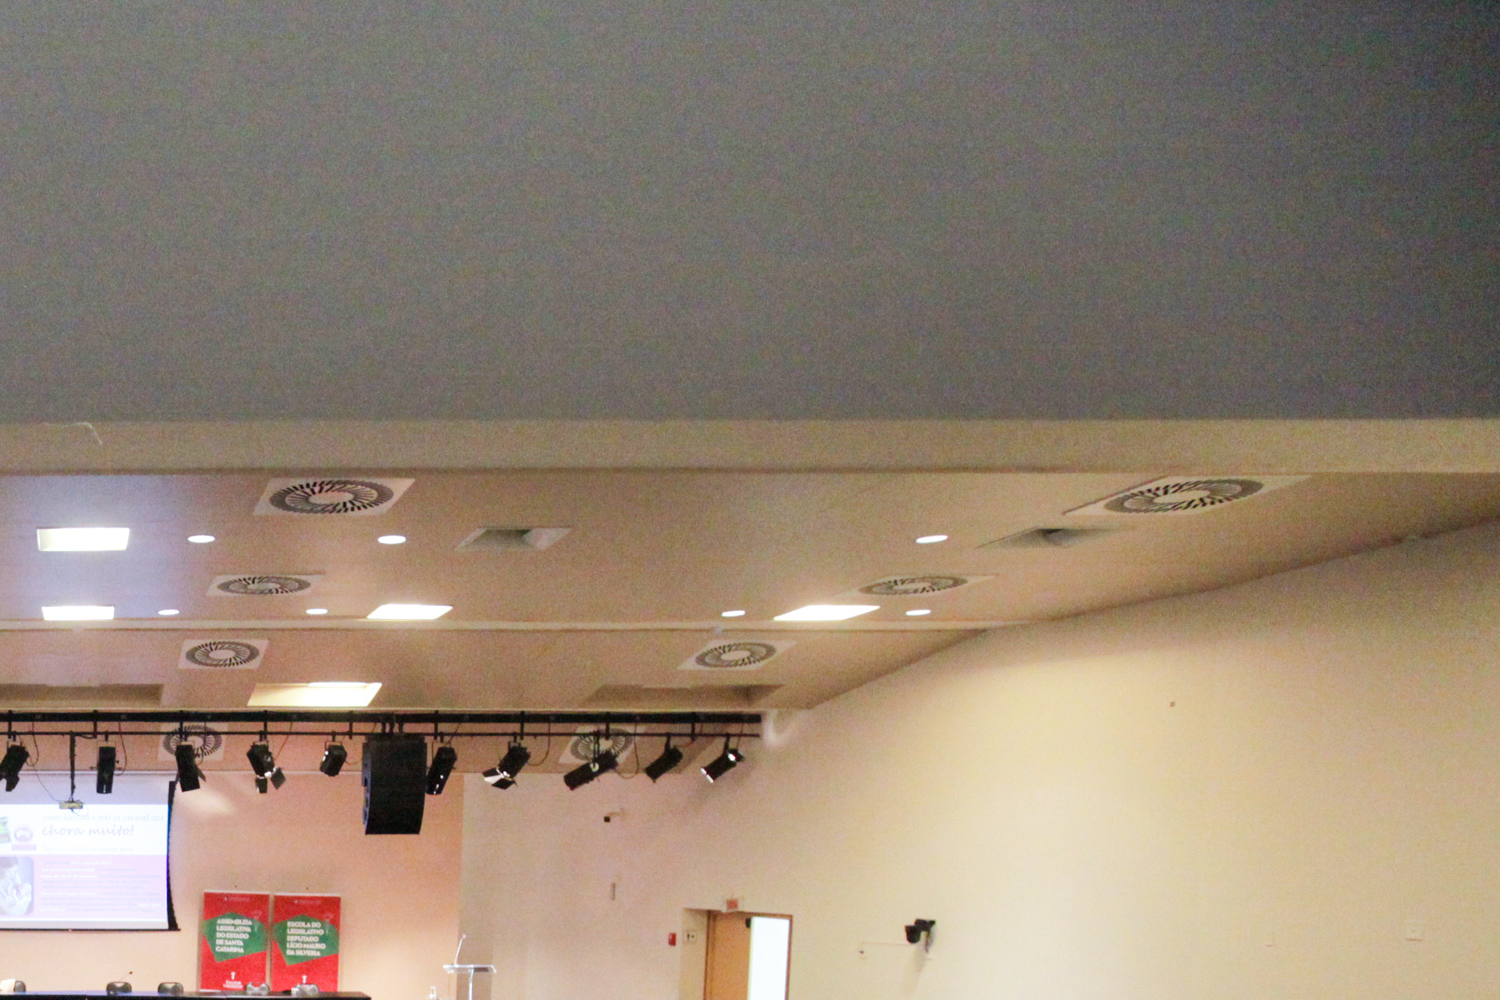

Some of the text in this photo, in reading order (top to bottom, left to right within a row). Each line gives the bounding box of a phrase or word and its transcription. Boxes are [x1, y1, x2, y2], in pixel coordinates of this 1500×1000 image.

[42, 824, 135, 836] chora muito!
[216, 918, 253, 926] ASSEMBLEIA
[216, 925, 252, 933] LEGISLATIVA
[226, 932, 250, 940] ESTADO
[286, 940, 326, 950] LÍCIO MAURO
[296, 949, 321, 957] SILVEIRA
